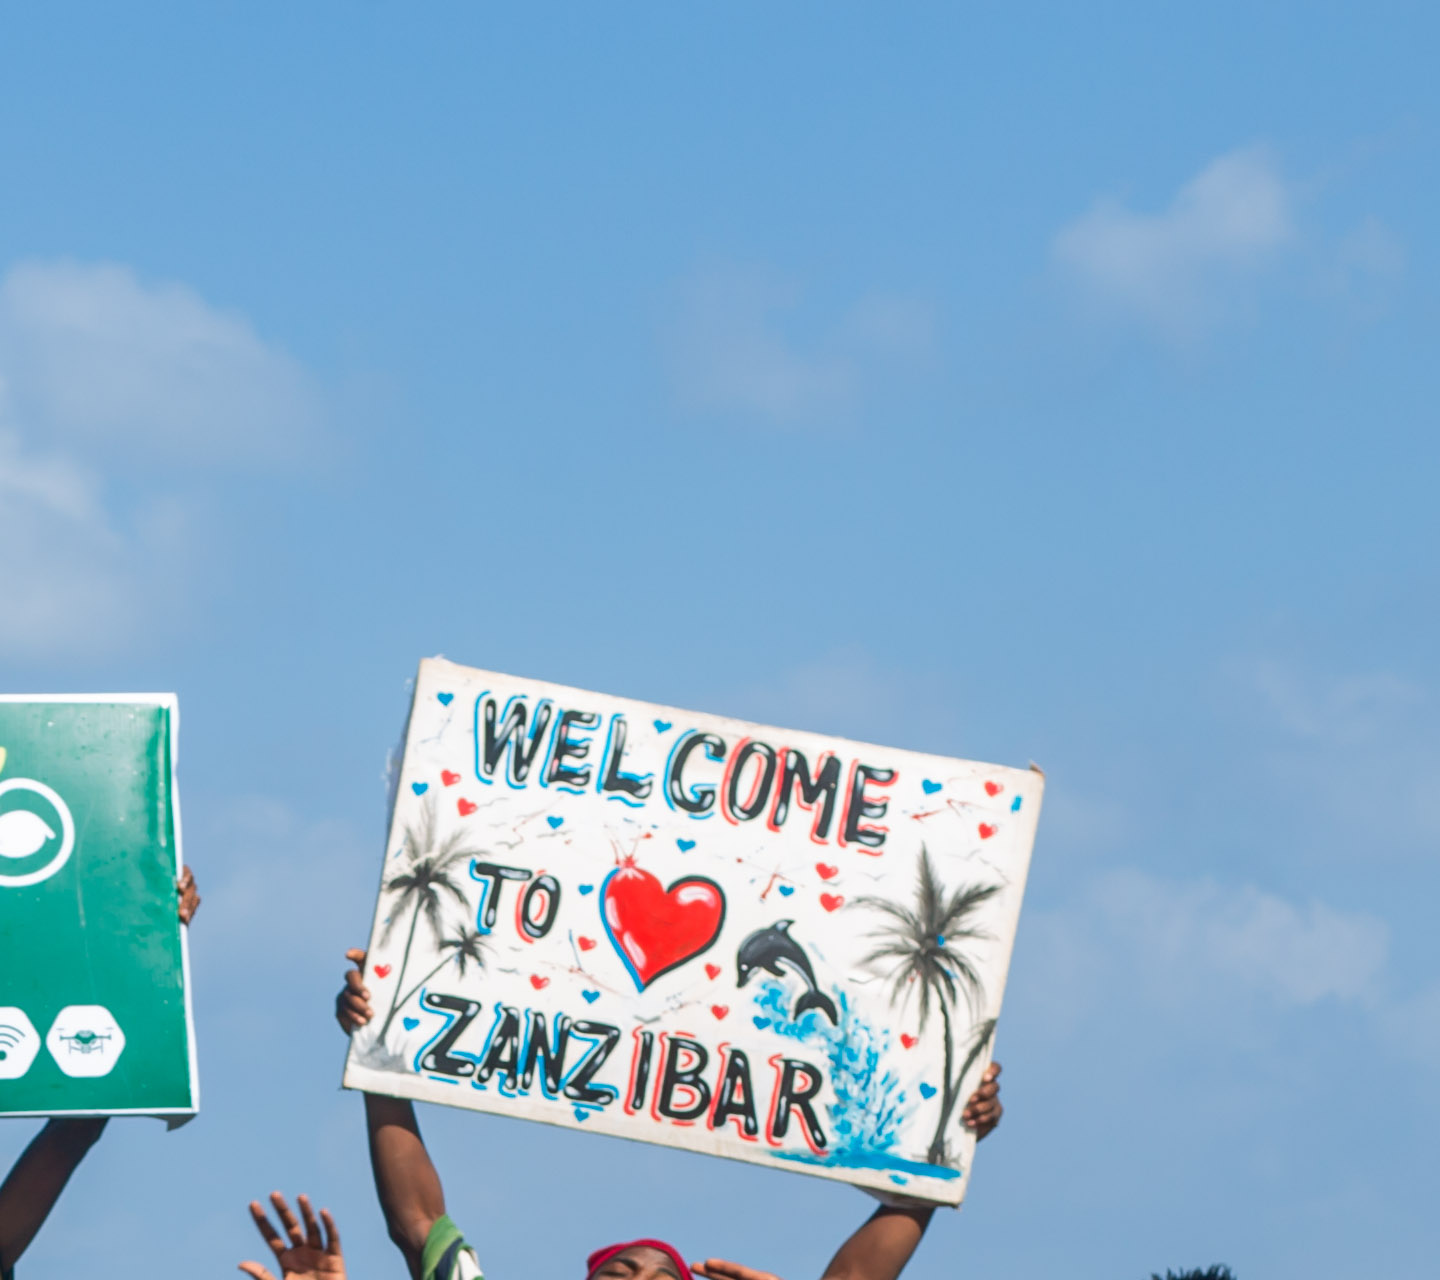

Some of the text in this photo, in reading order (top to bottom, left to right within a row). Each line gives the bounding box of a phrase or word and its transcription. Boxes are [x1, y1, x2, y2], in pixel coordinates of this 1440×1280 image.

[477, 692, 898, 854] WELCOME
[471, 860, 562, 942] TO
[417, 990, 829, 1155] ZANZIBAR
